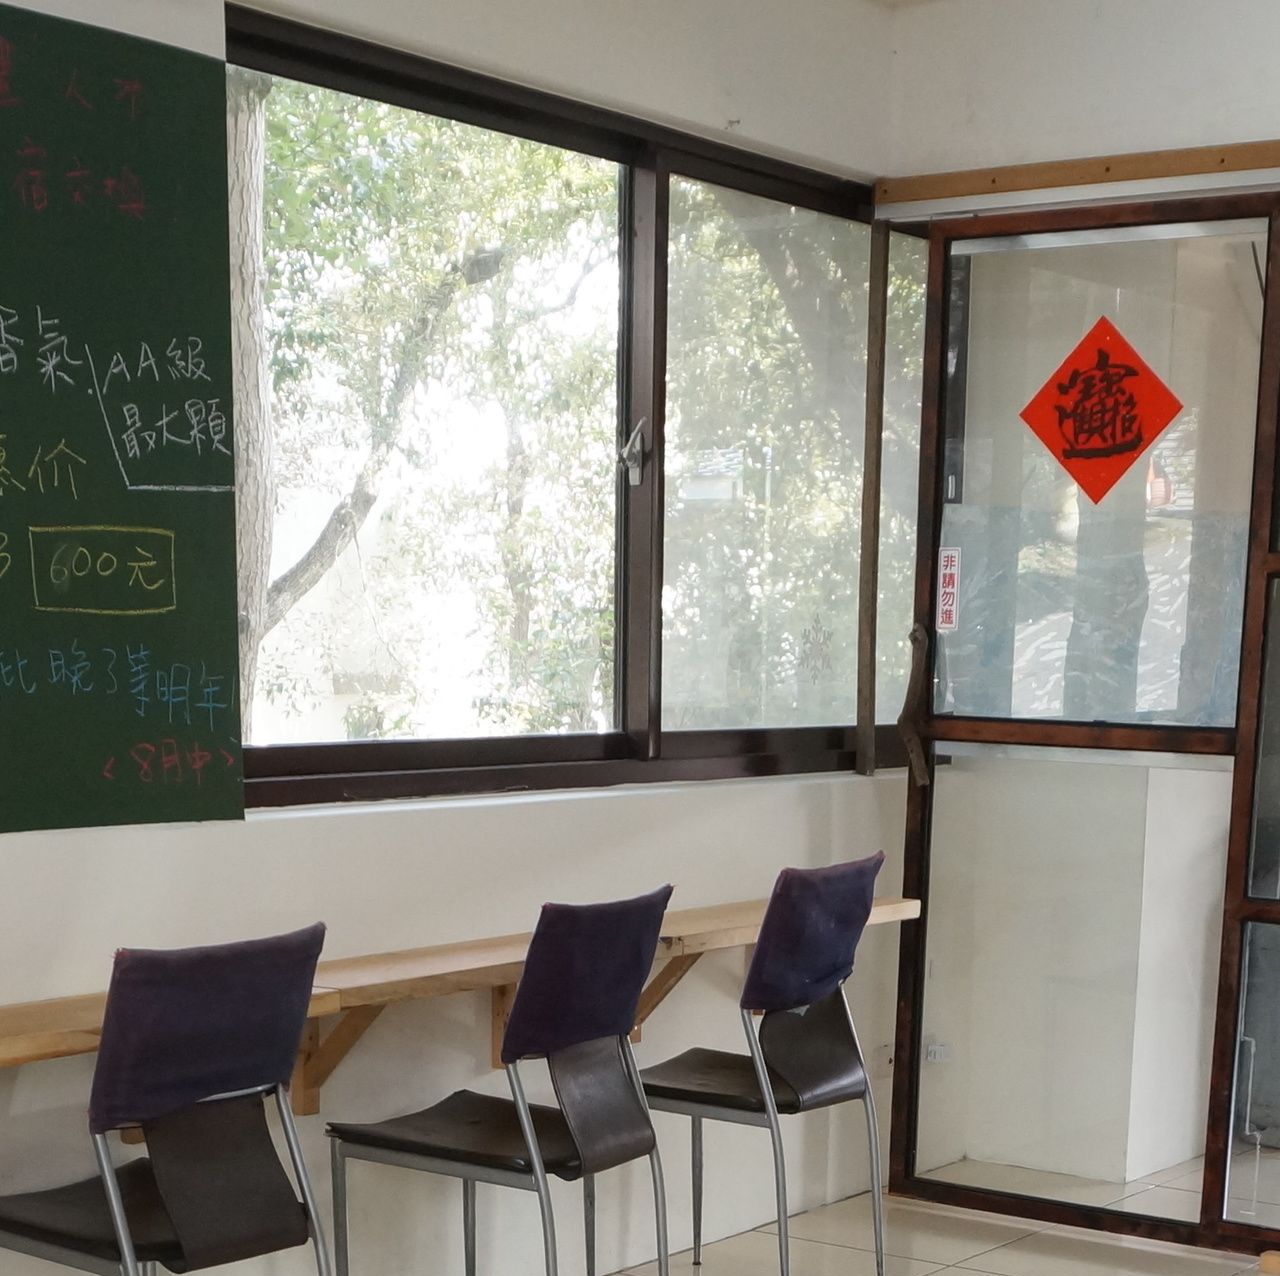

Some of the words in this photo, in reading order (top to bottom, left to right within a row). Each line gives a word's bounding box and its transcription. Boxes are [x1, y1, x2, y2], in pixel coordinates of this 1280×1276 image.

[102, 336, 213, 394] AA級
[121, 399, 232, 460] 最大顆
[50, 545, 165, 590] 600元
[939, 552, 958, 626] 非請勿進
